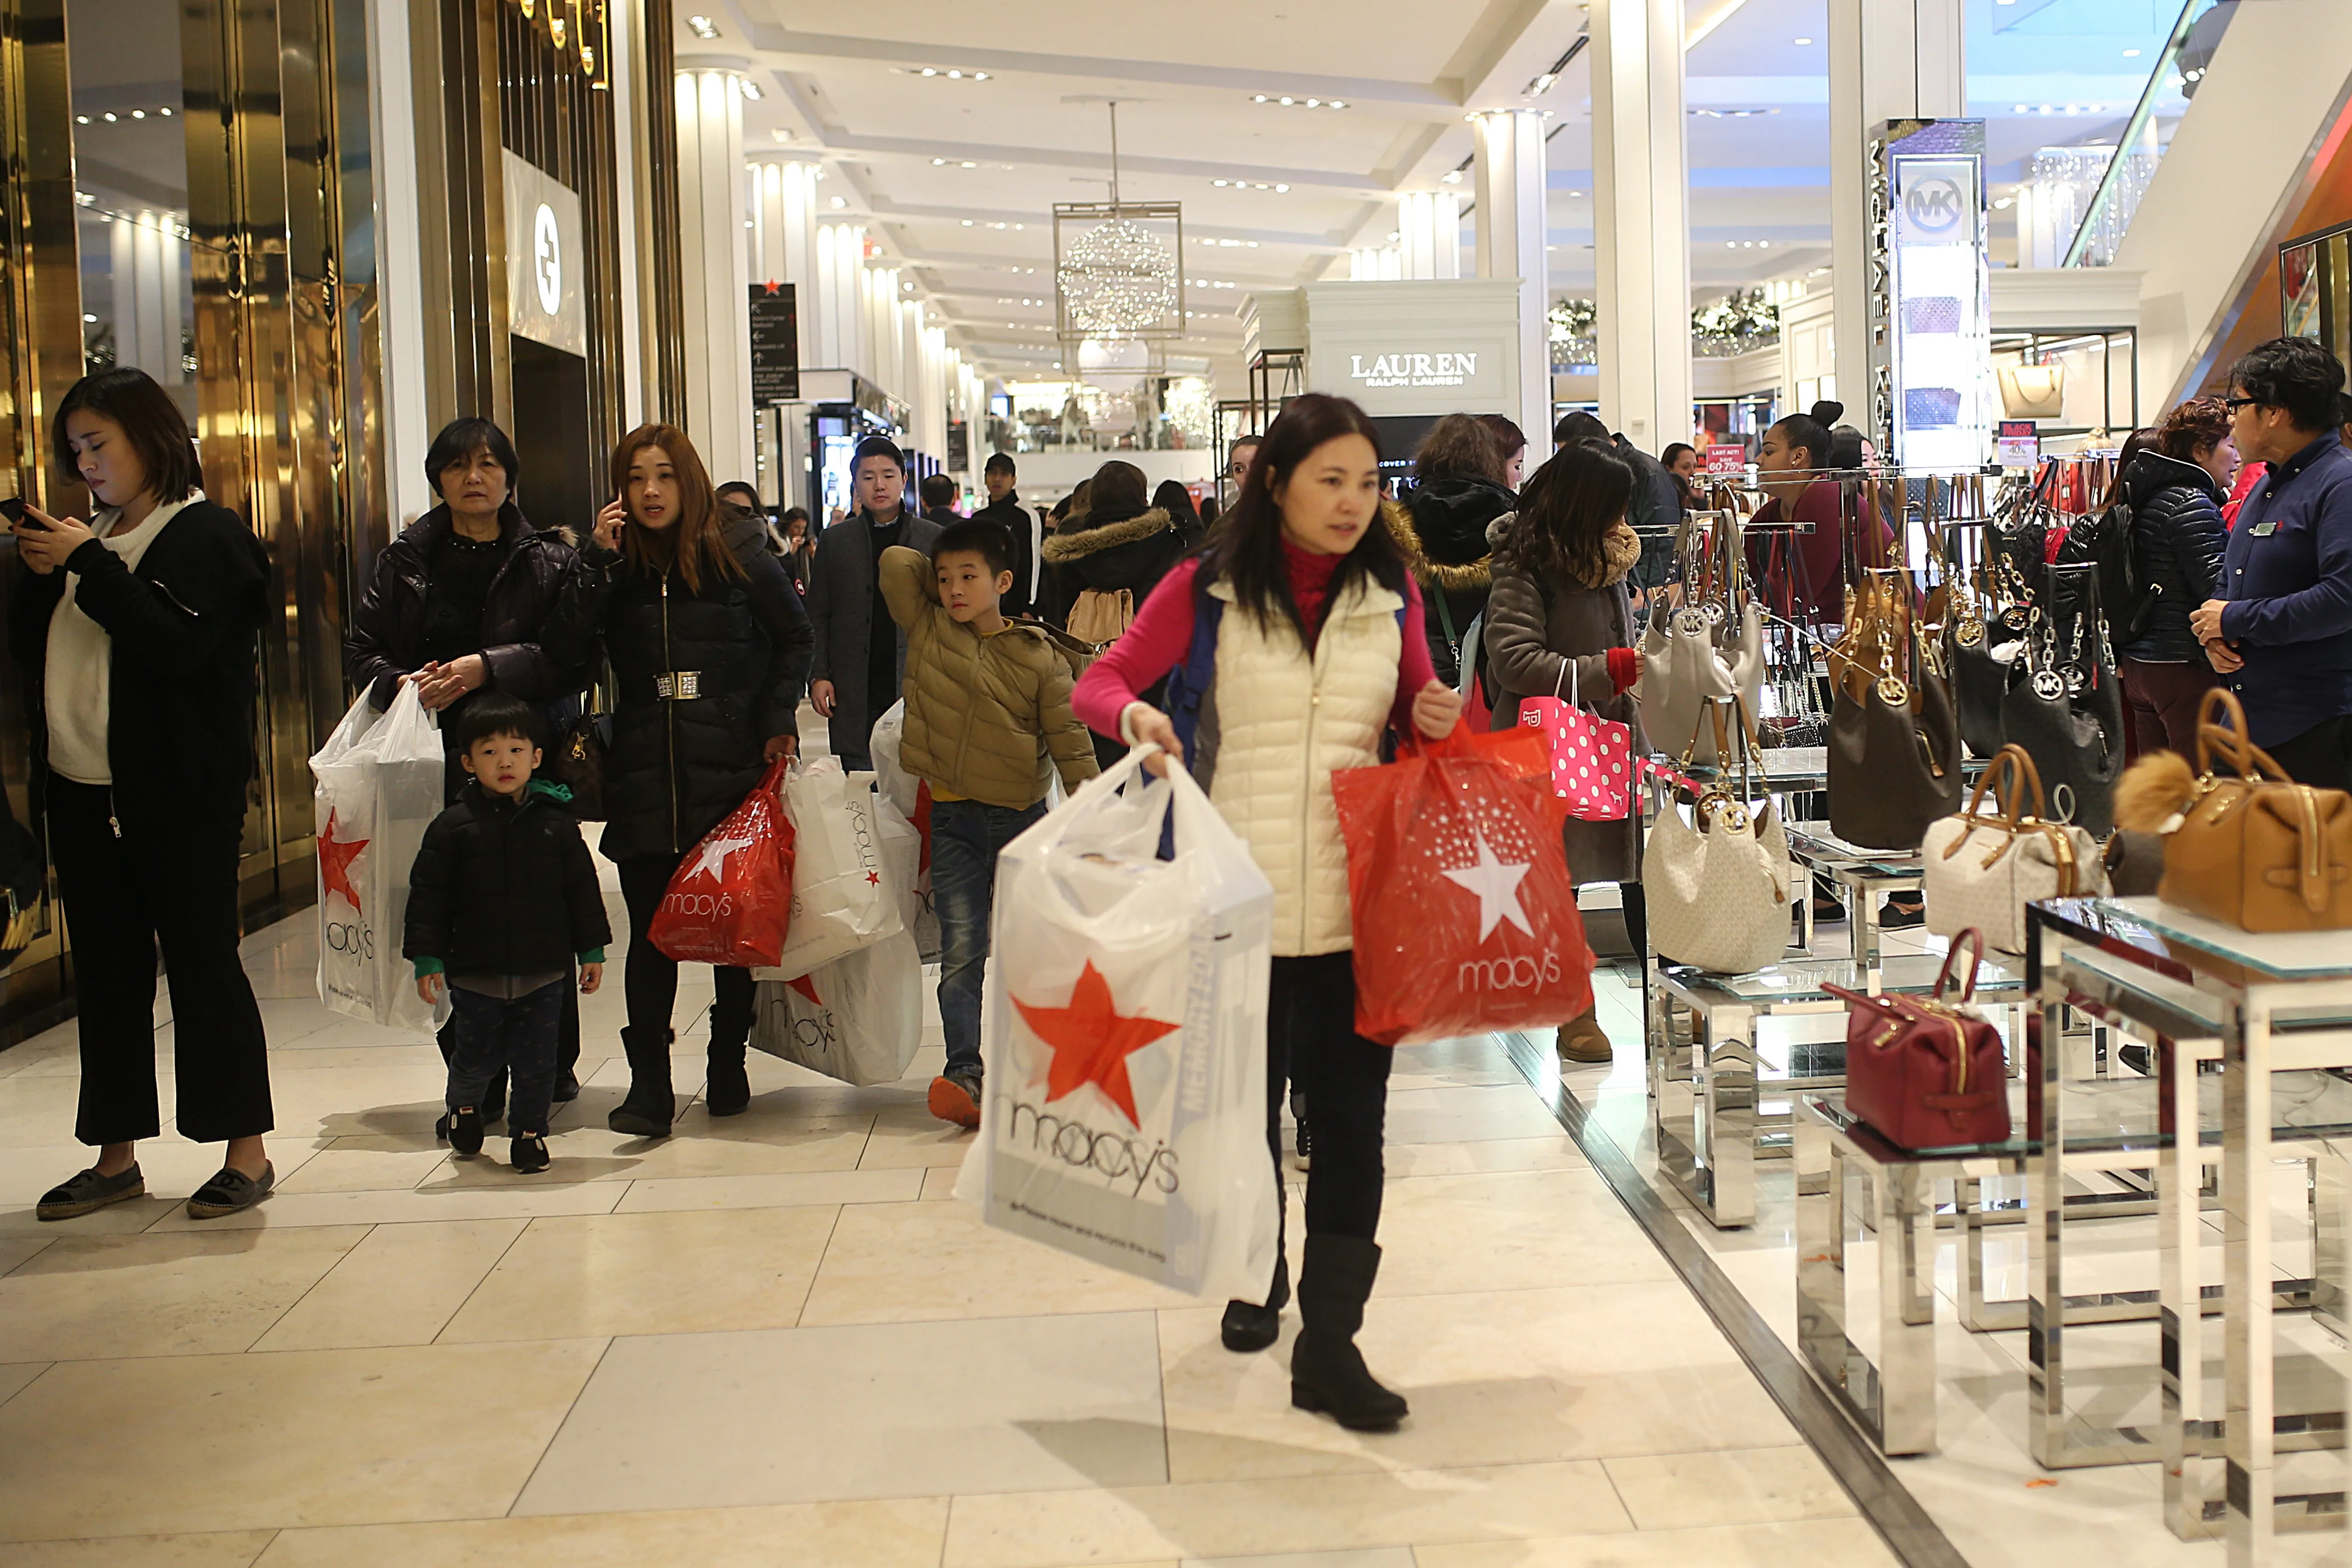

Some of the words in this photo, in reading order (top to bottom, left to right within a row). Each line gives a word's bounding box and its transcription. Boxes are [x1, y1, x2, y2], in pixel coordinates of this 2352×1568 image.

[1350, 353, 1478, 377] LAUREN
[1365, 377, 1409, 387] RALPH
[1411, 376, 1464, 386] LAUREN
[846, 801, 877, 868] macy's
[662, 892, 732, 922] macy's
[326, 922, 373, 966] acy's
[1458, 947, 1560, 995] macy's
[1010, 1102, 1179, 1199] macy's
